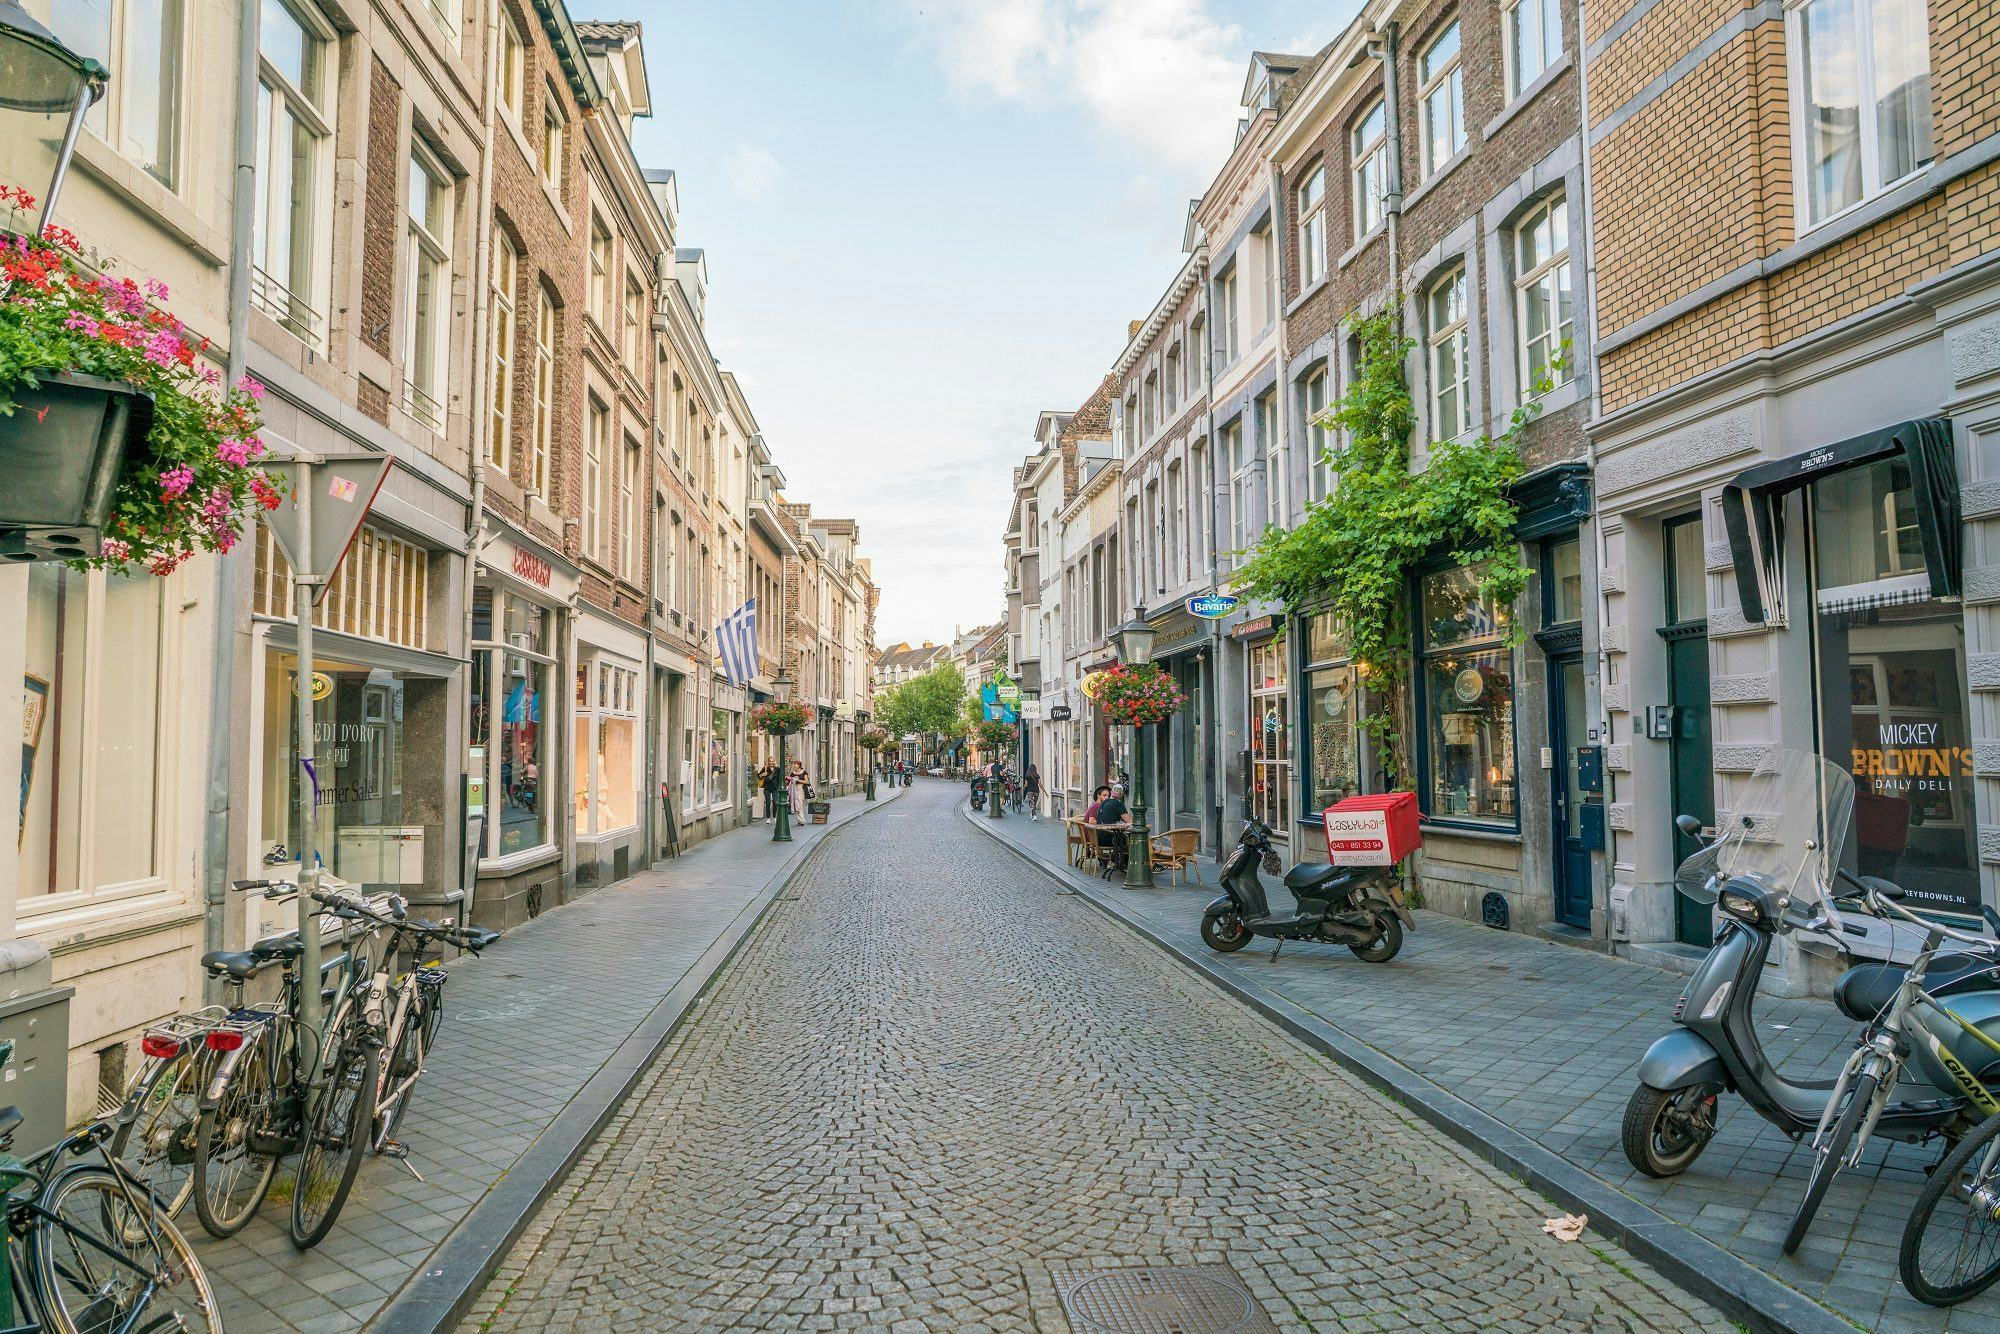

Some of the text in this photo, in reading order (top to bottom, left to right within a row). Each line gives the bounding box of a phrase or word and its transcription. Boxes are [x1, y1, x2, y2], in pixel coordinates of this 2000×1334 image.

[1194, 601, 1234, 612] Bavaria
[314, 722, 374, 743] EDI D'ORO
[1880, 723, 1937, 745] MICKEY
[1851, 746, 1975, 777] BROWN'S
[351, 779, 373, 802] Sale
[1875, 779, 1953, 791] DAILY DELI
[1362, 841, 1372, 849] 33
[1944, 1059, 1996, 1107] GIANT
